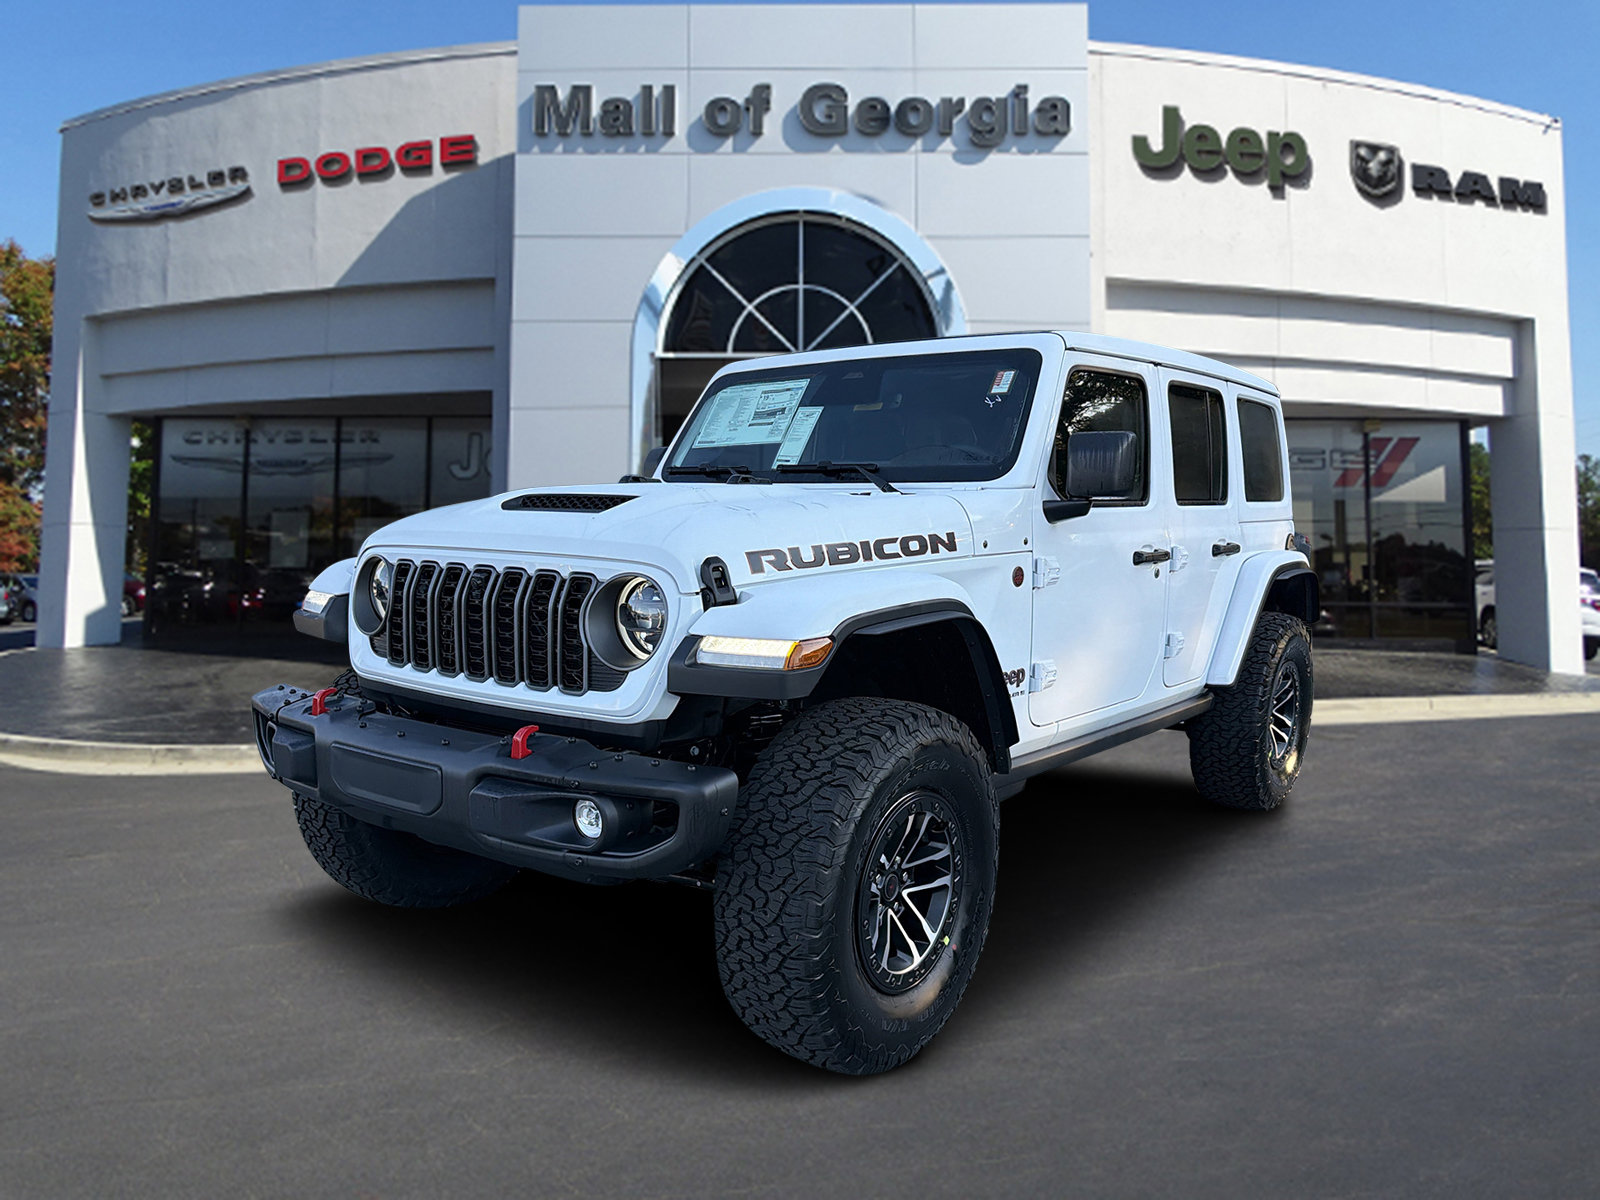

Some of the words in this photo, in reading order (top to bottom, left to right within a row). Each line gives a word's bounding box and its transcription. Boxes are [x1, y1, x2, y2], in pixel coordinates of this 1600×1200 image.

[531, 83, 676, 138] Mall
[702, 83, 772, 138] of
[798, 83, 1073, 149] Georgia
[277, 134, 479, 187] DODGE
[1131, 105, 1312, 196] Jeep
[88, 165, 251, 208] CHRYSLER
[1411, 163, 1547, 213] RAM
[182, 428, 382, 446] CHRYSLER
[744, 532, 958, 574] RUBICON
[1002, 668, 1026, 689] eep
